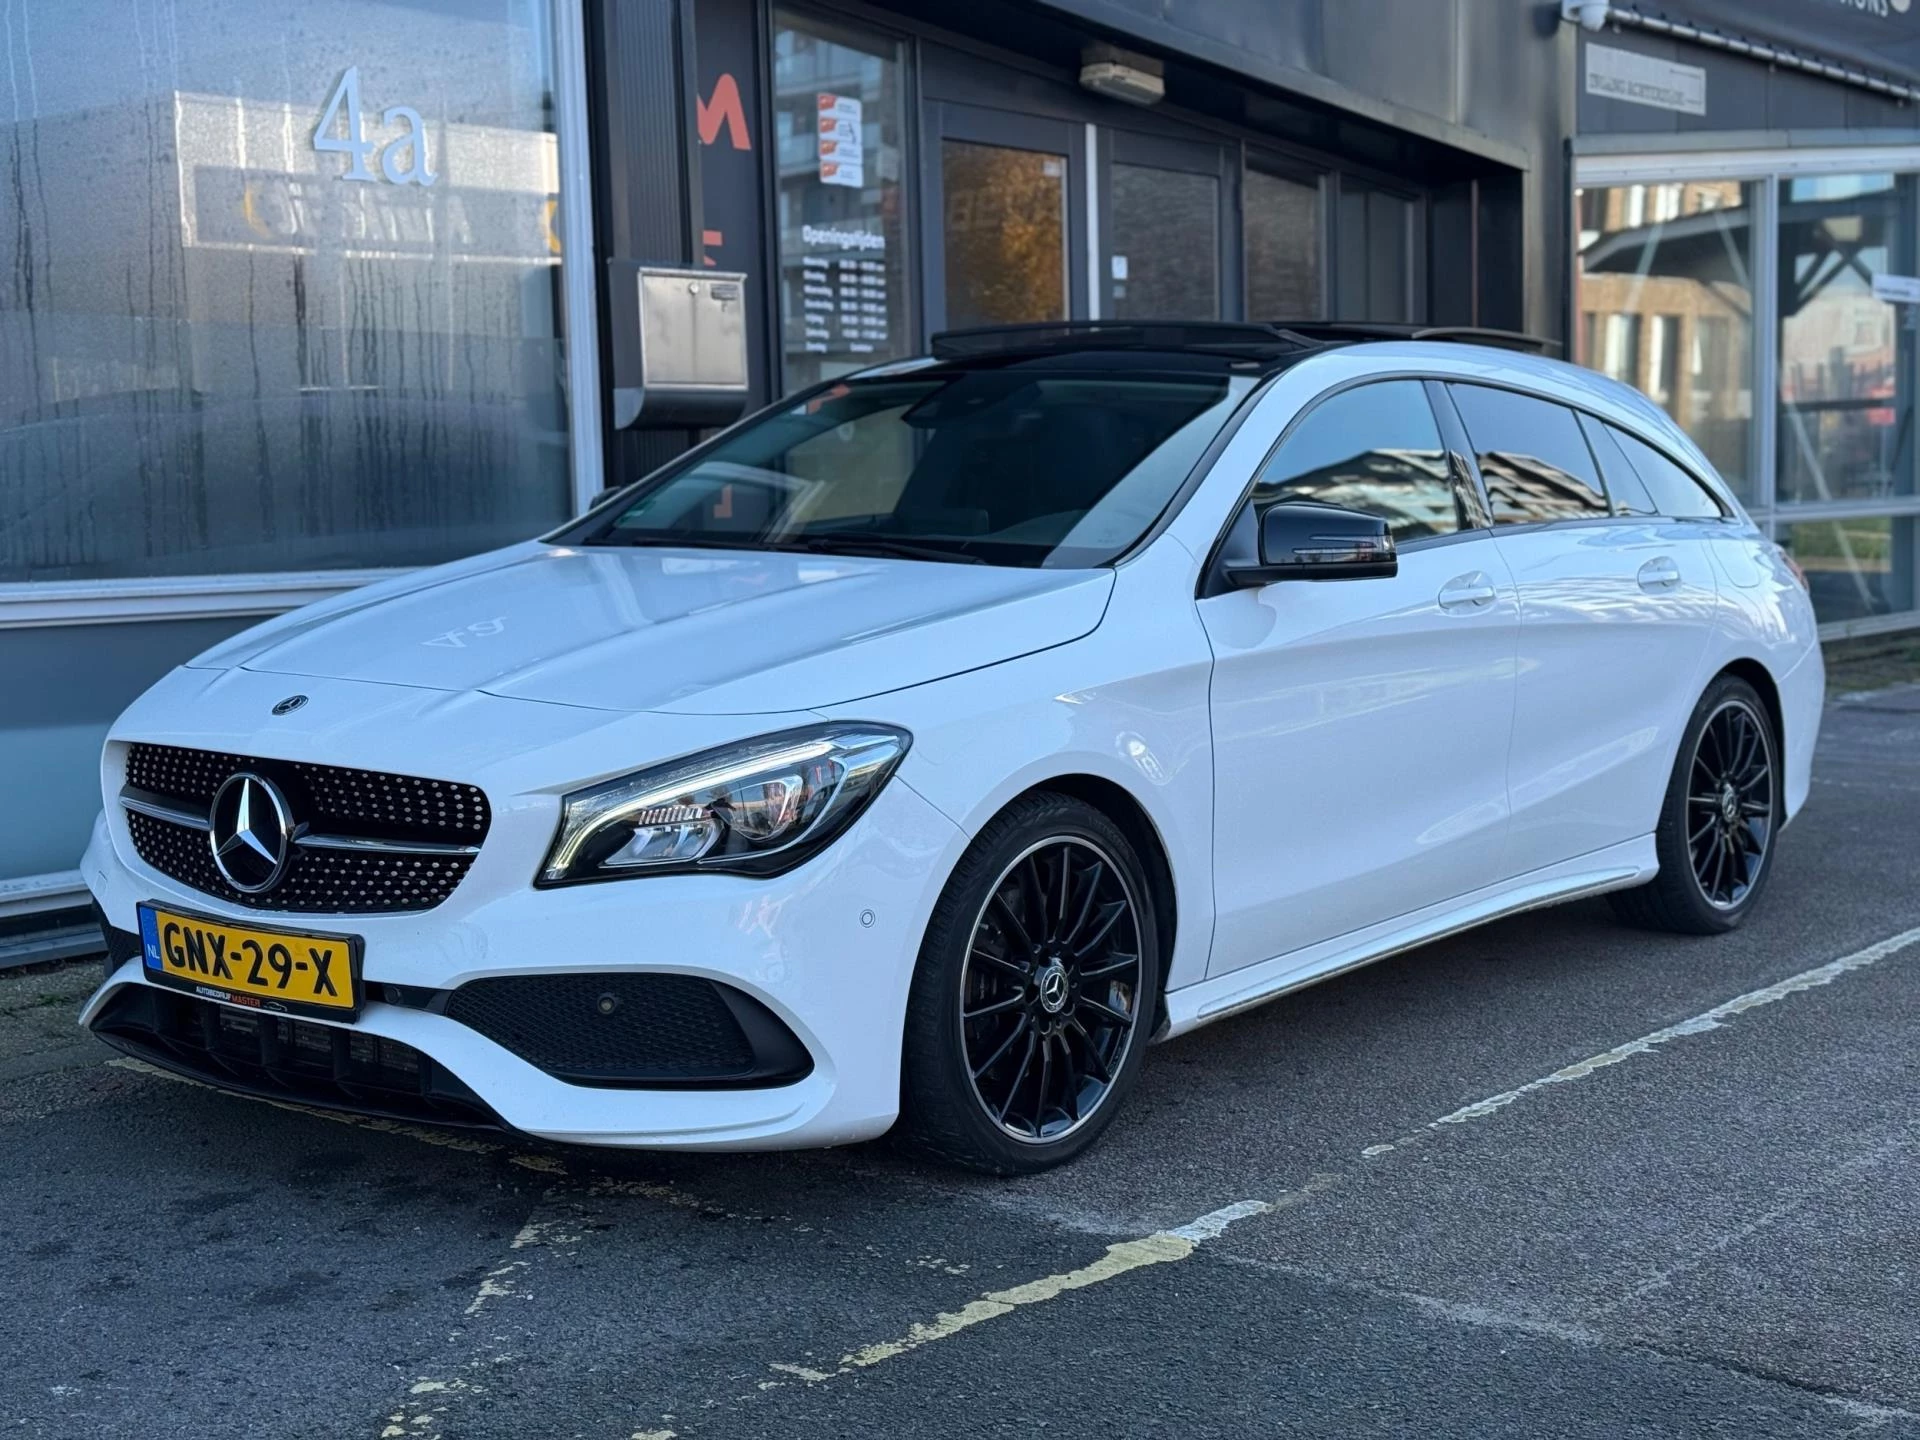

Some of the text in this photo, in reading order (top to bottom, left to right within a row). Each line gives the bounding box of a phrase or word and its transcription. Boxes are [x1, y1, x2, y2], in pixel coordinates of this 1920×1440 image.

[312, 64, 439, 187] 4a
[147, 946, 161, 960] NL
[163, 921, 338, 997] GNX-29-X
